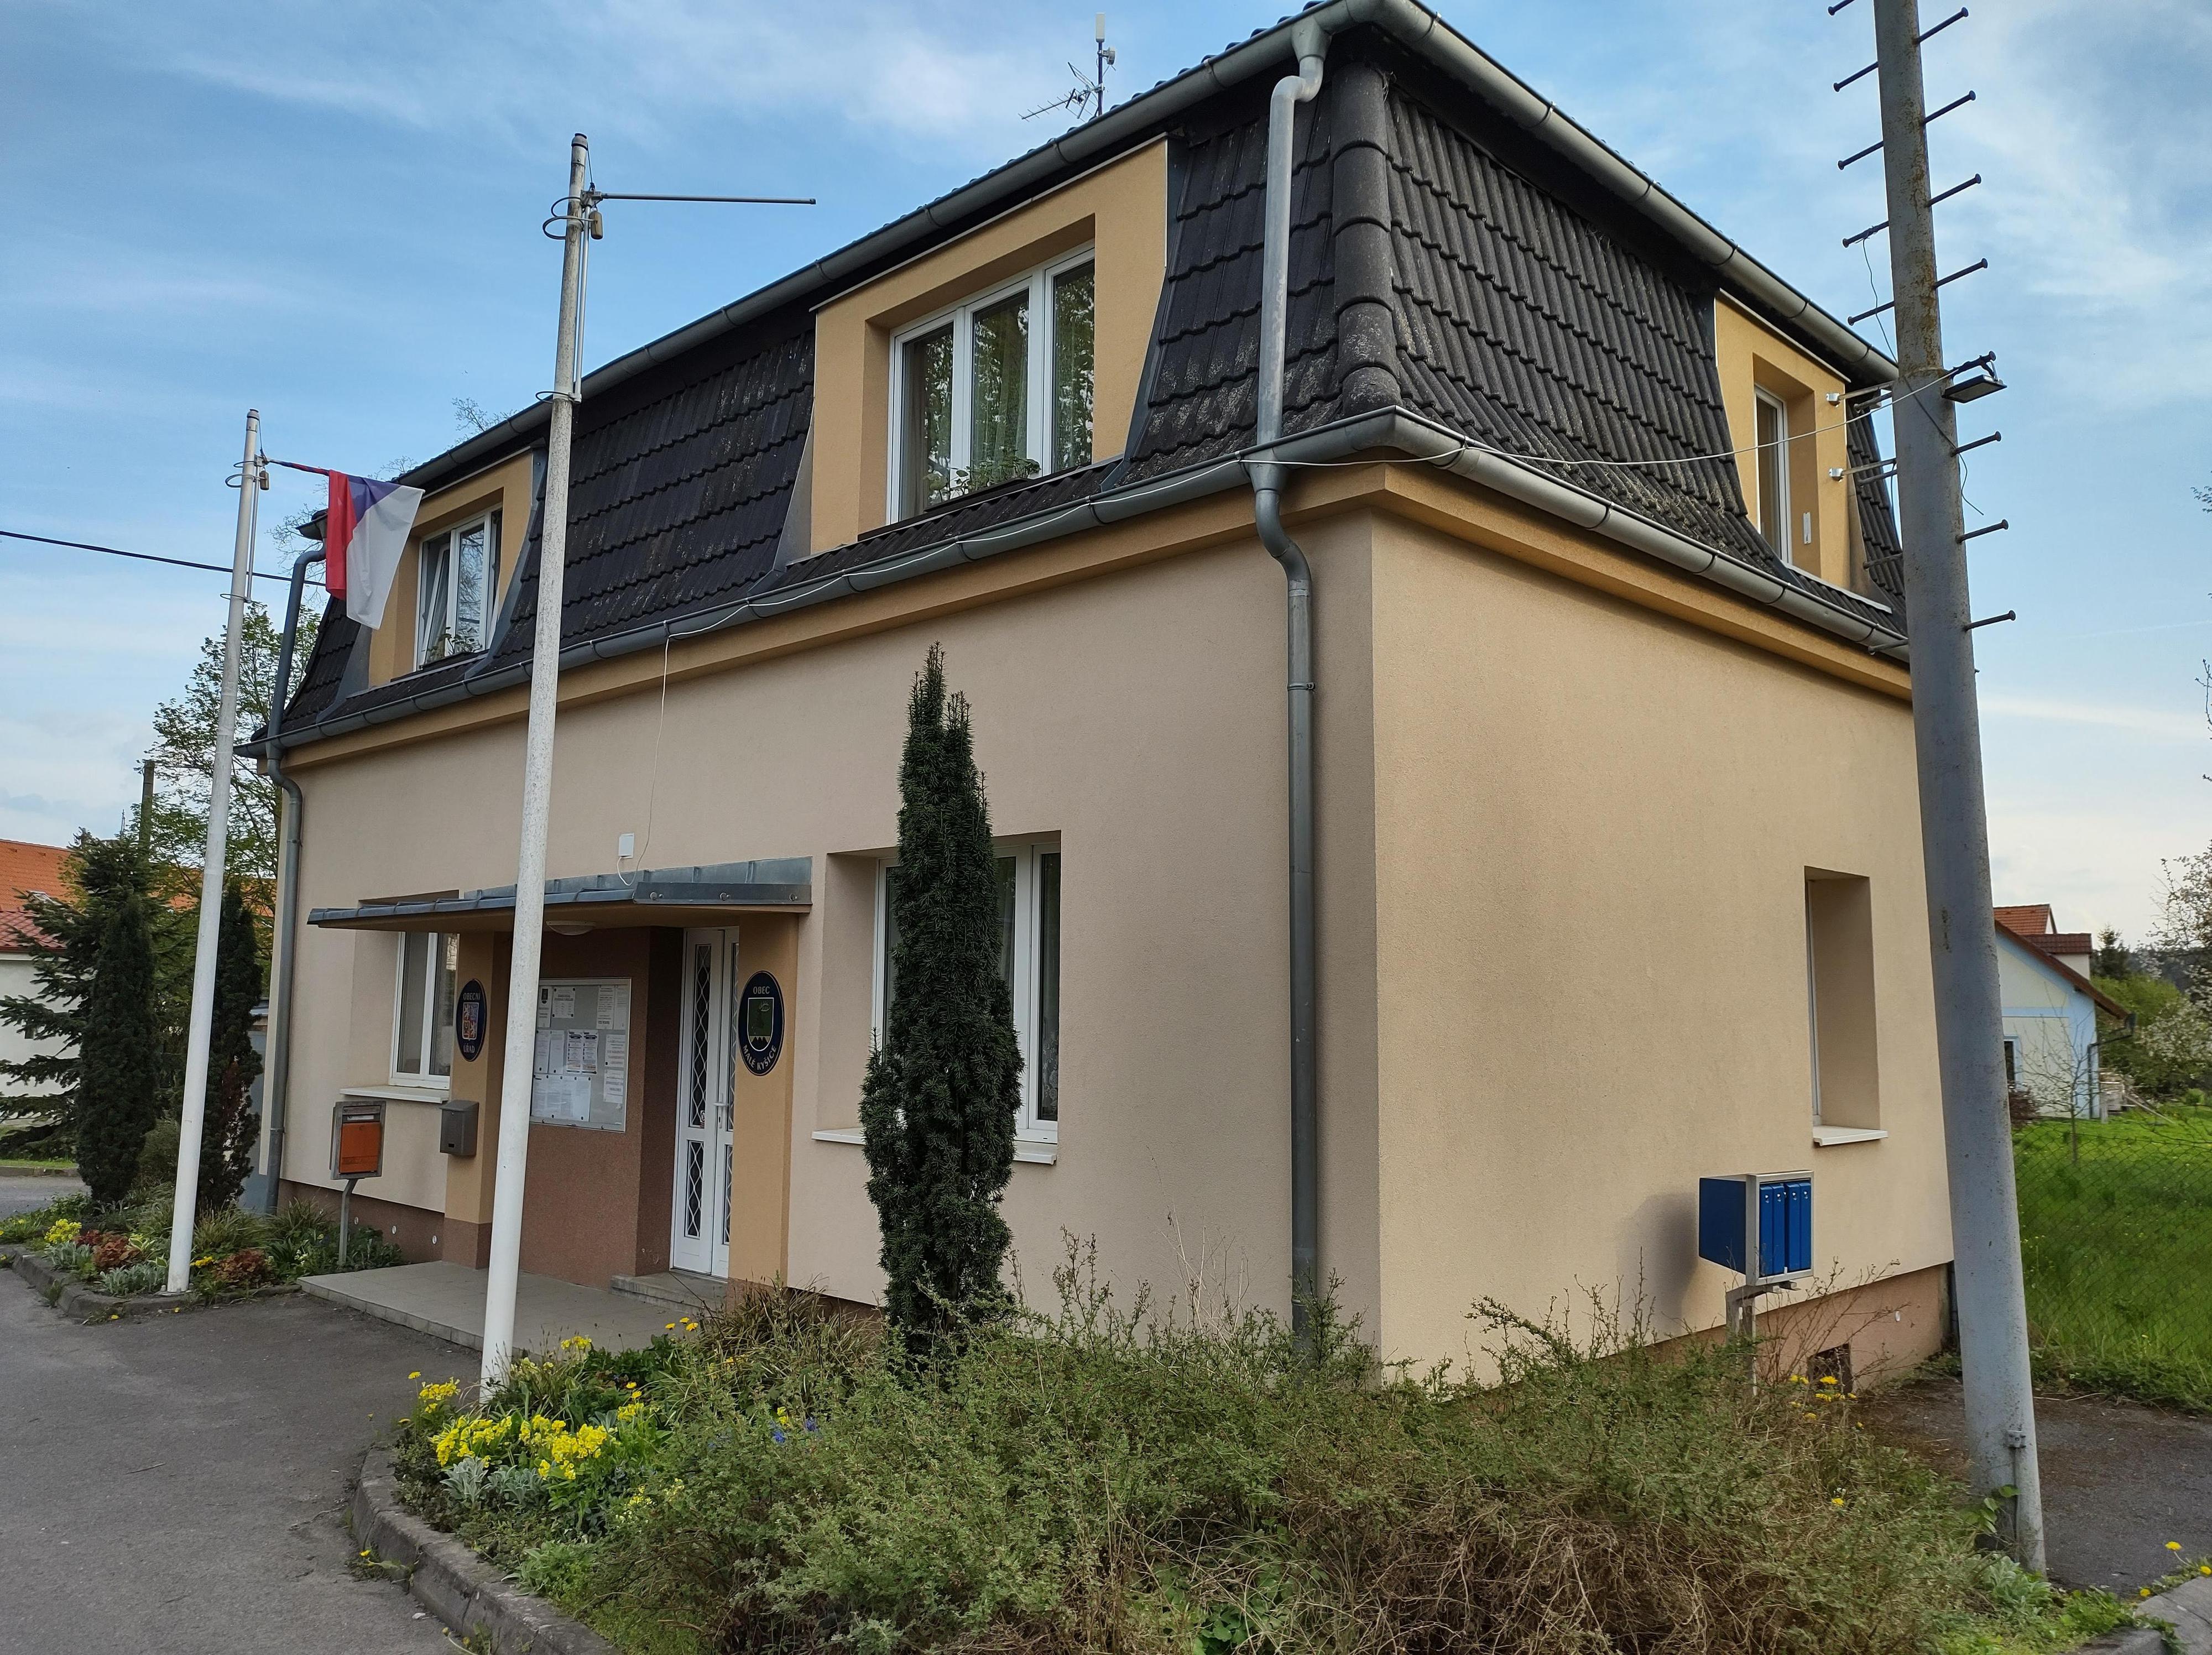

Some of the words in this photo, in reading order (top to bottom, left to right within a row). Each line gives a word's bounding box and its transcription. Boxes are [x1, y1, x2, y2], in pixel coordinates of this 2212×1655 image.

[753, 986, 770, 994] OBEC
[743, 1044, 755, 1068] MALÉ
[757, 1045, 777, 1071] KYŠICE
